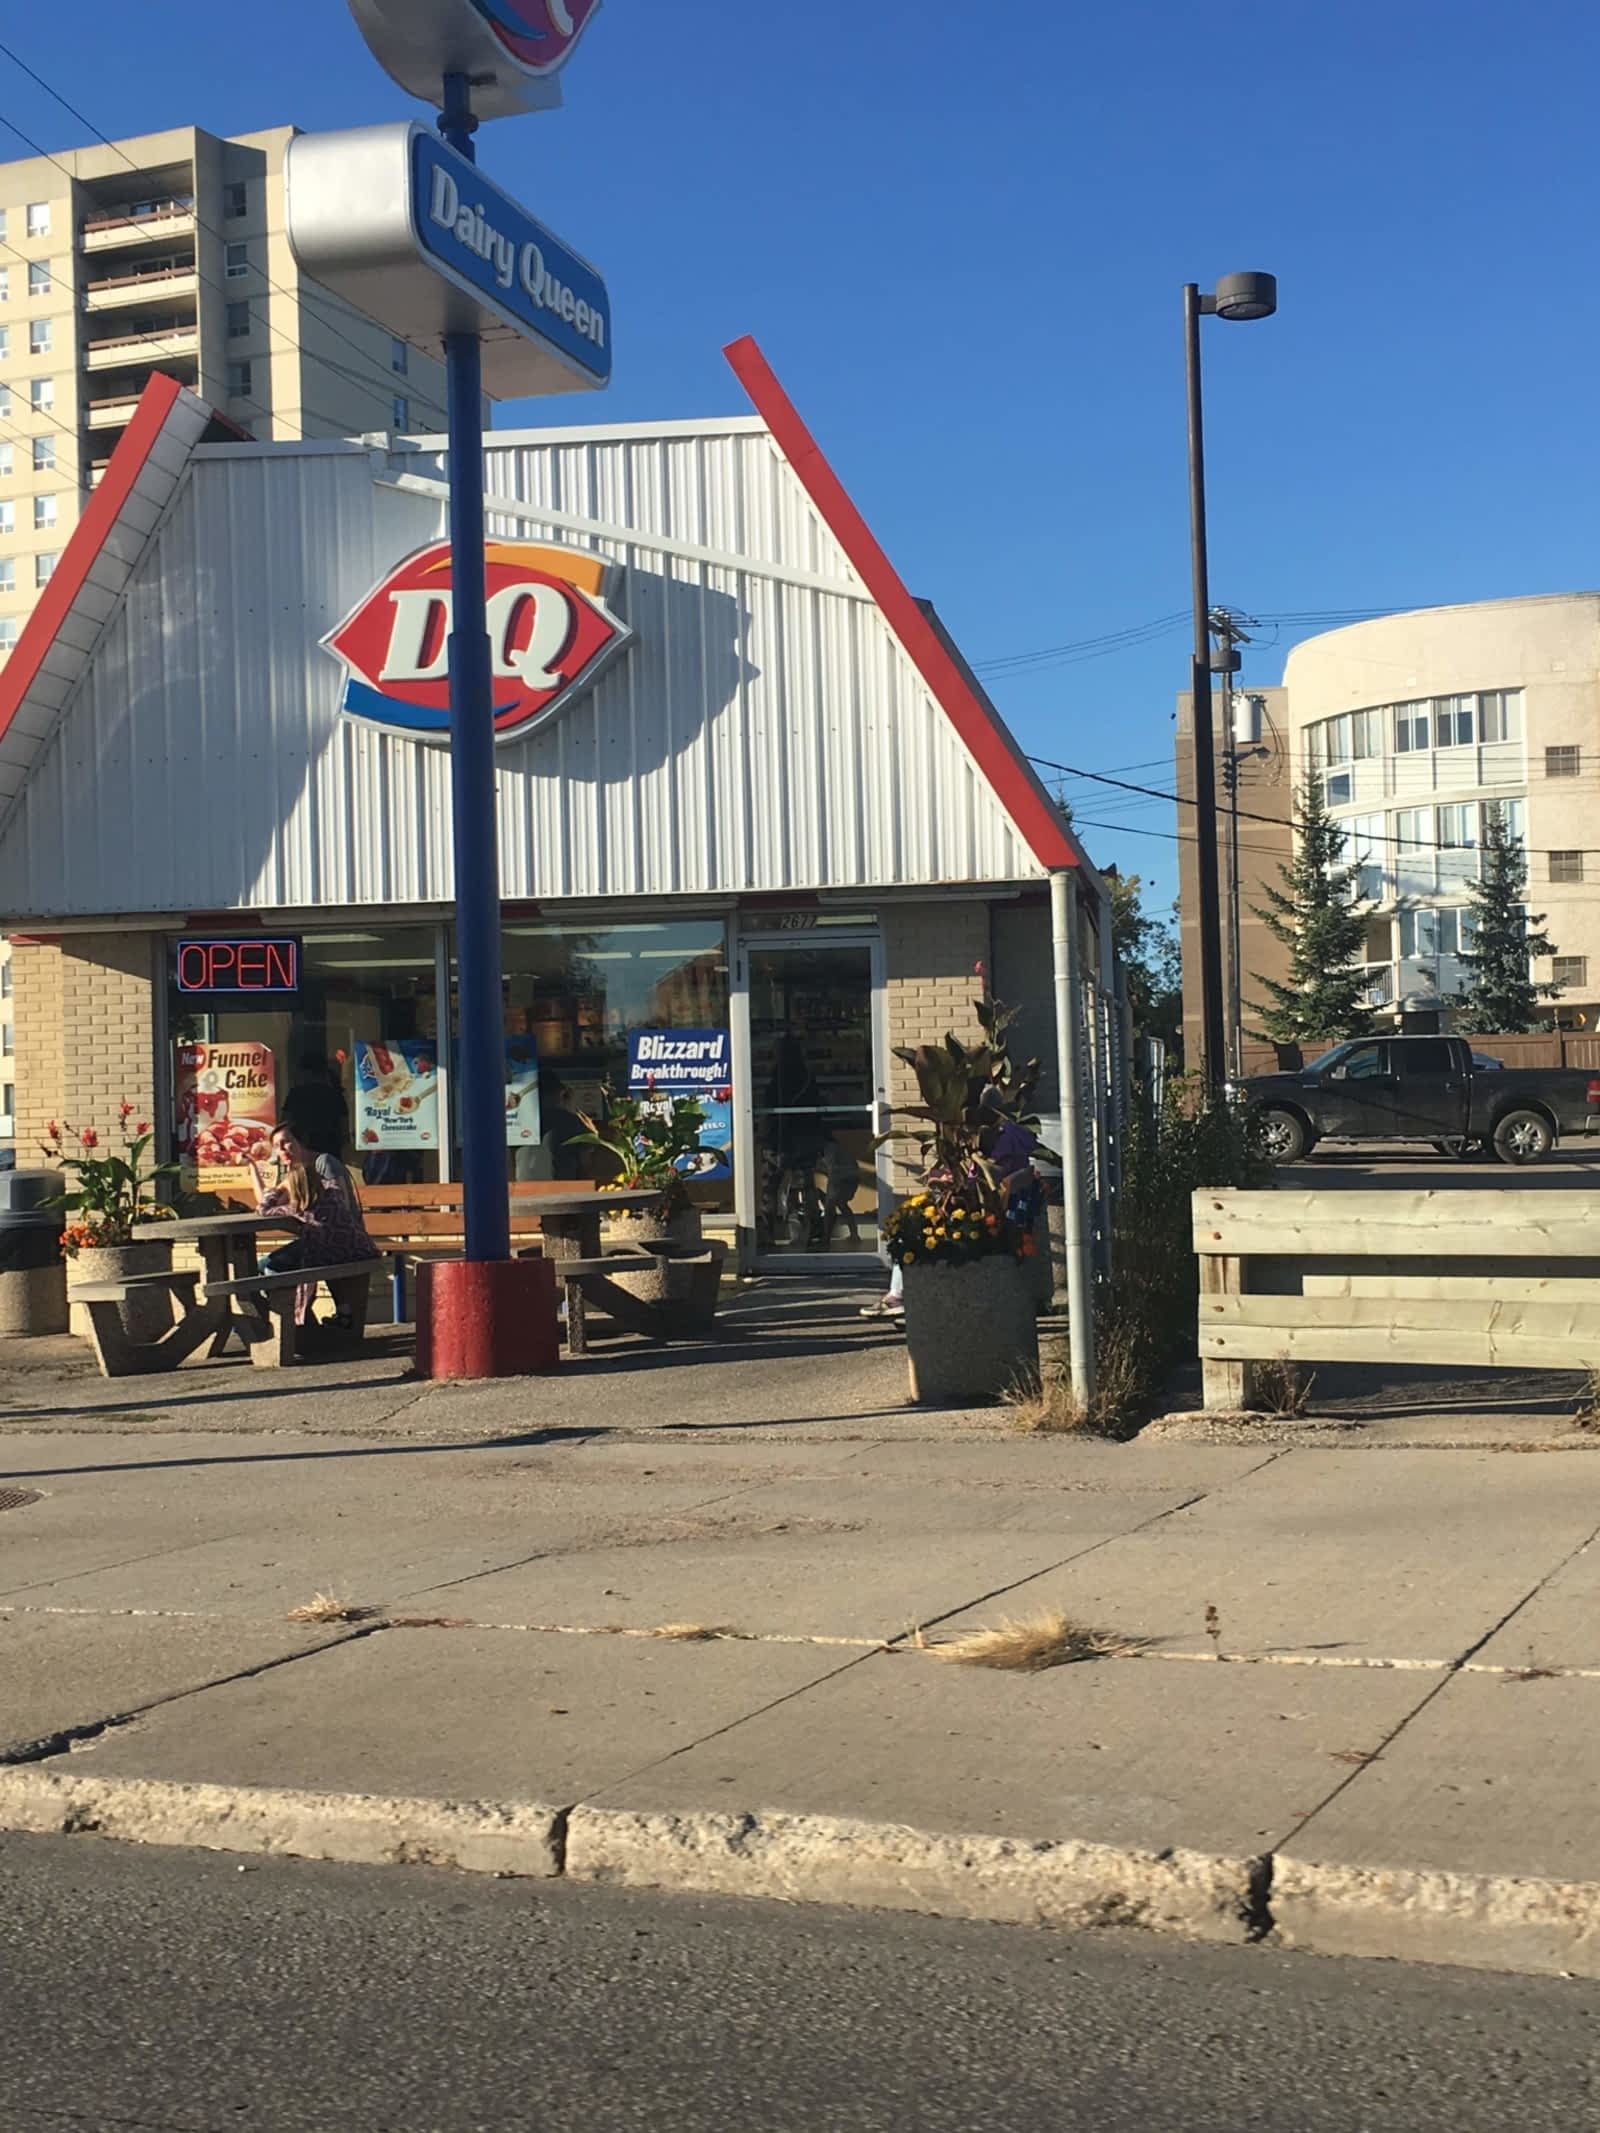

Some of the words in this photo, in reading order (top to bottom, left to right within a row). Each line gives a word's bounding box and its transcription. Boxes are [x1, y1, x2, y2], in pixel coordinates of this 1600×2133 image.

[429, 163, 515, 289] Dairy
[518, 241, 605, 349] Queen
[378, 581, 563, 693] DQ
[180, 943, 294, 989] OPEN
[207, 1048, 268, 1069] Funnel
[636, 1034, 725, 1061] Blizzard
[225, 1069, 268, 1089] Cake
[631, 1062, 728, 1082] Breakthrough!
[364, 1106, 392, 1119] Royal
